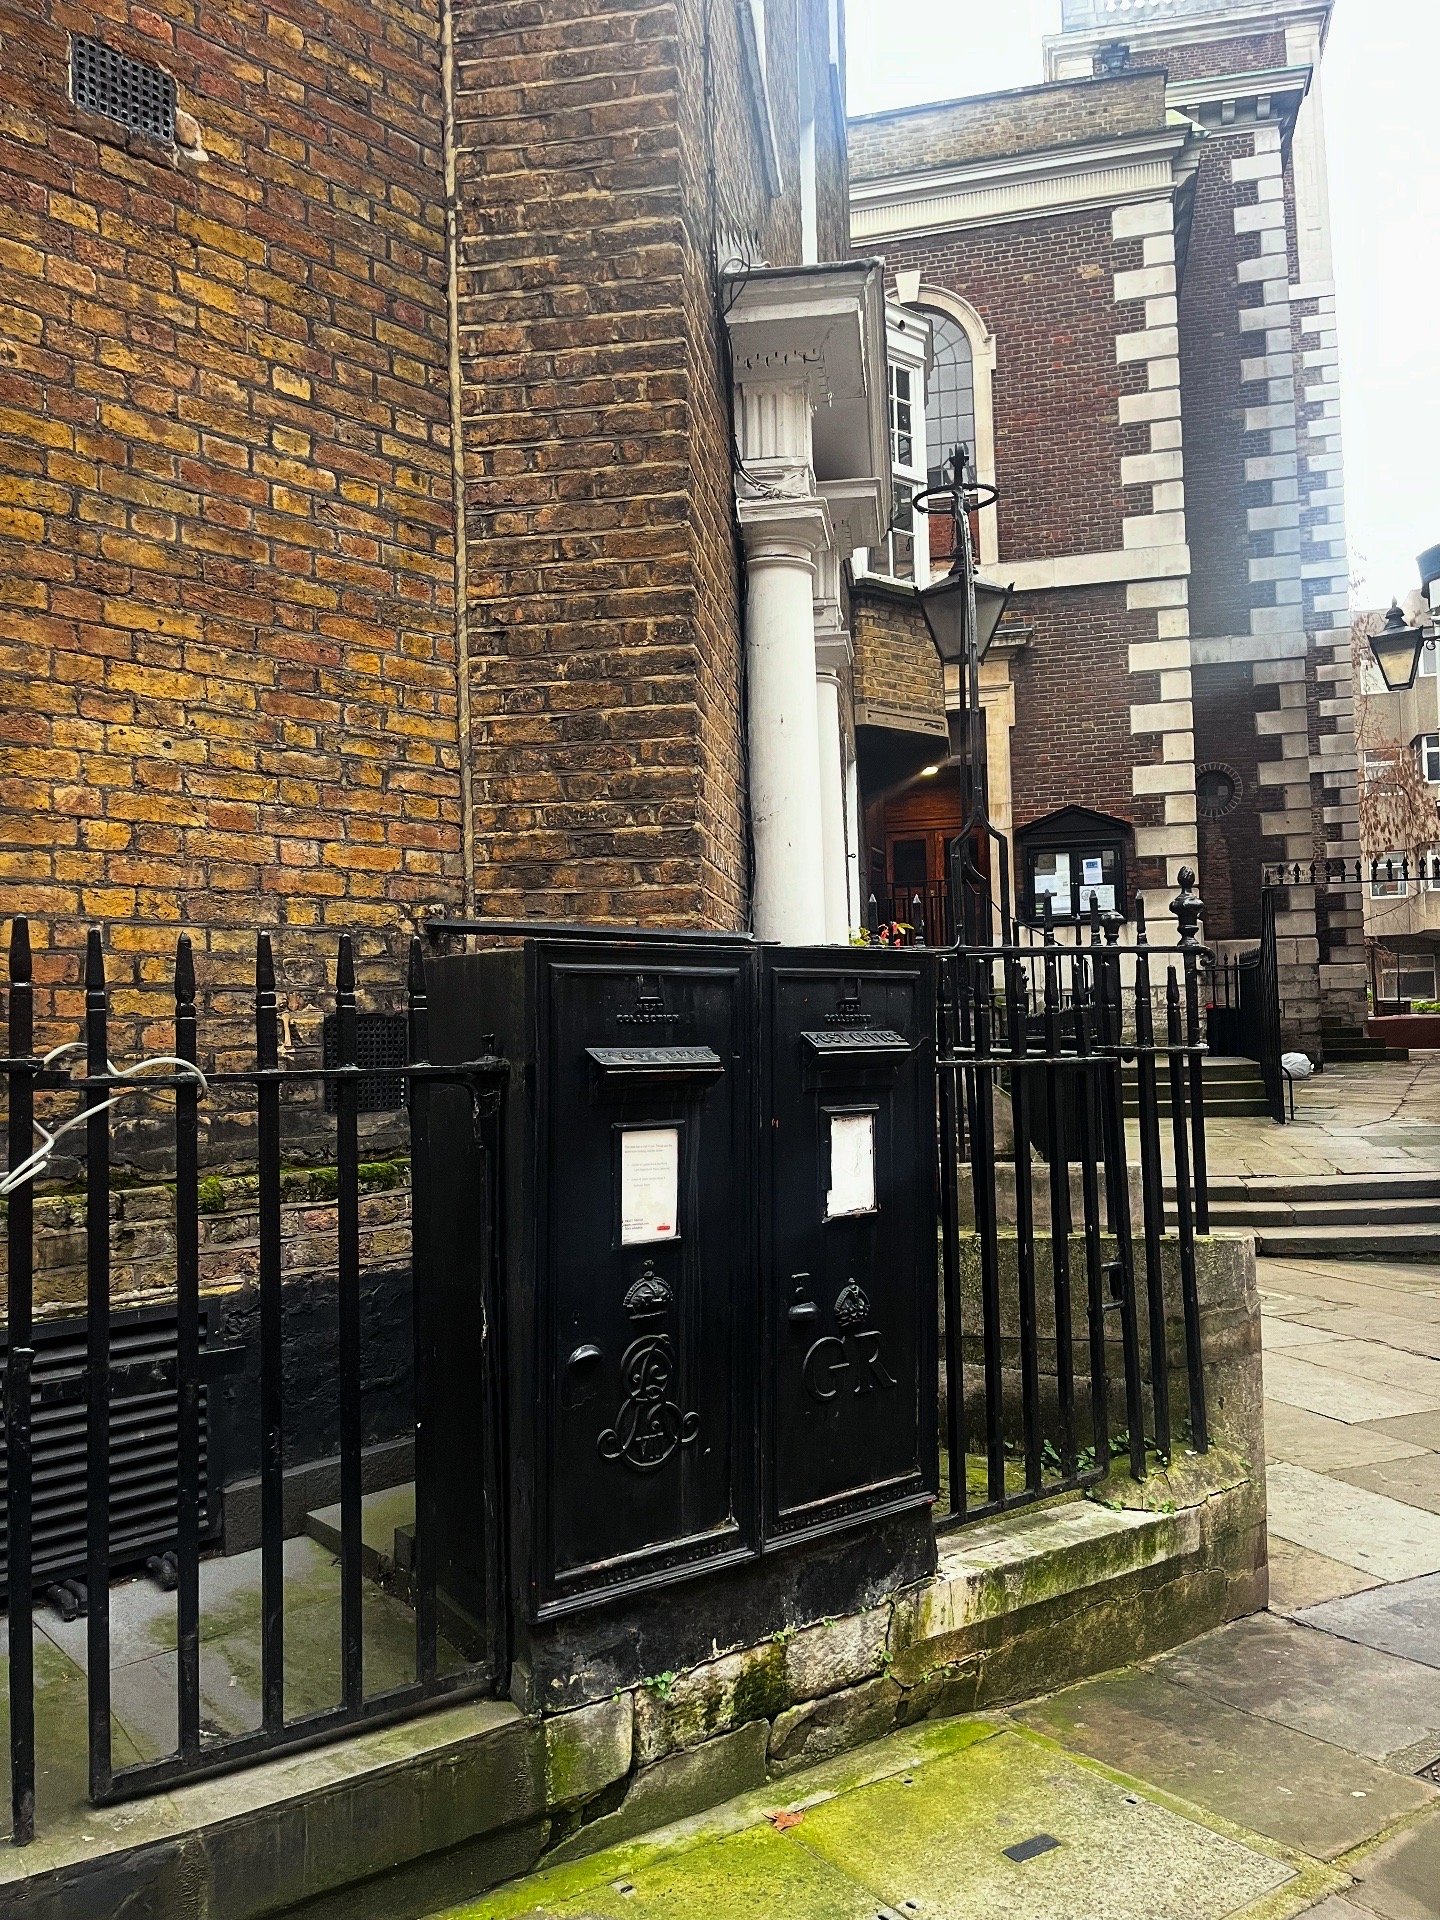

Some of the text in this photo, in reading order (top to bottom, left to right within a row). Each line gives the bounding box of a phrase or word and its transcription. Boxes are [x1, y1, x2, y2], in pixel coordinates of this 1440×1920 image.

[616, 1014, 680, 1024] COLLECTION
[805, 1031, 905, 1044] POST OFFICE
[801, 1330, 898, 1402] GR
